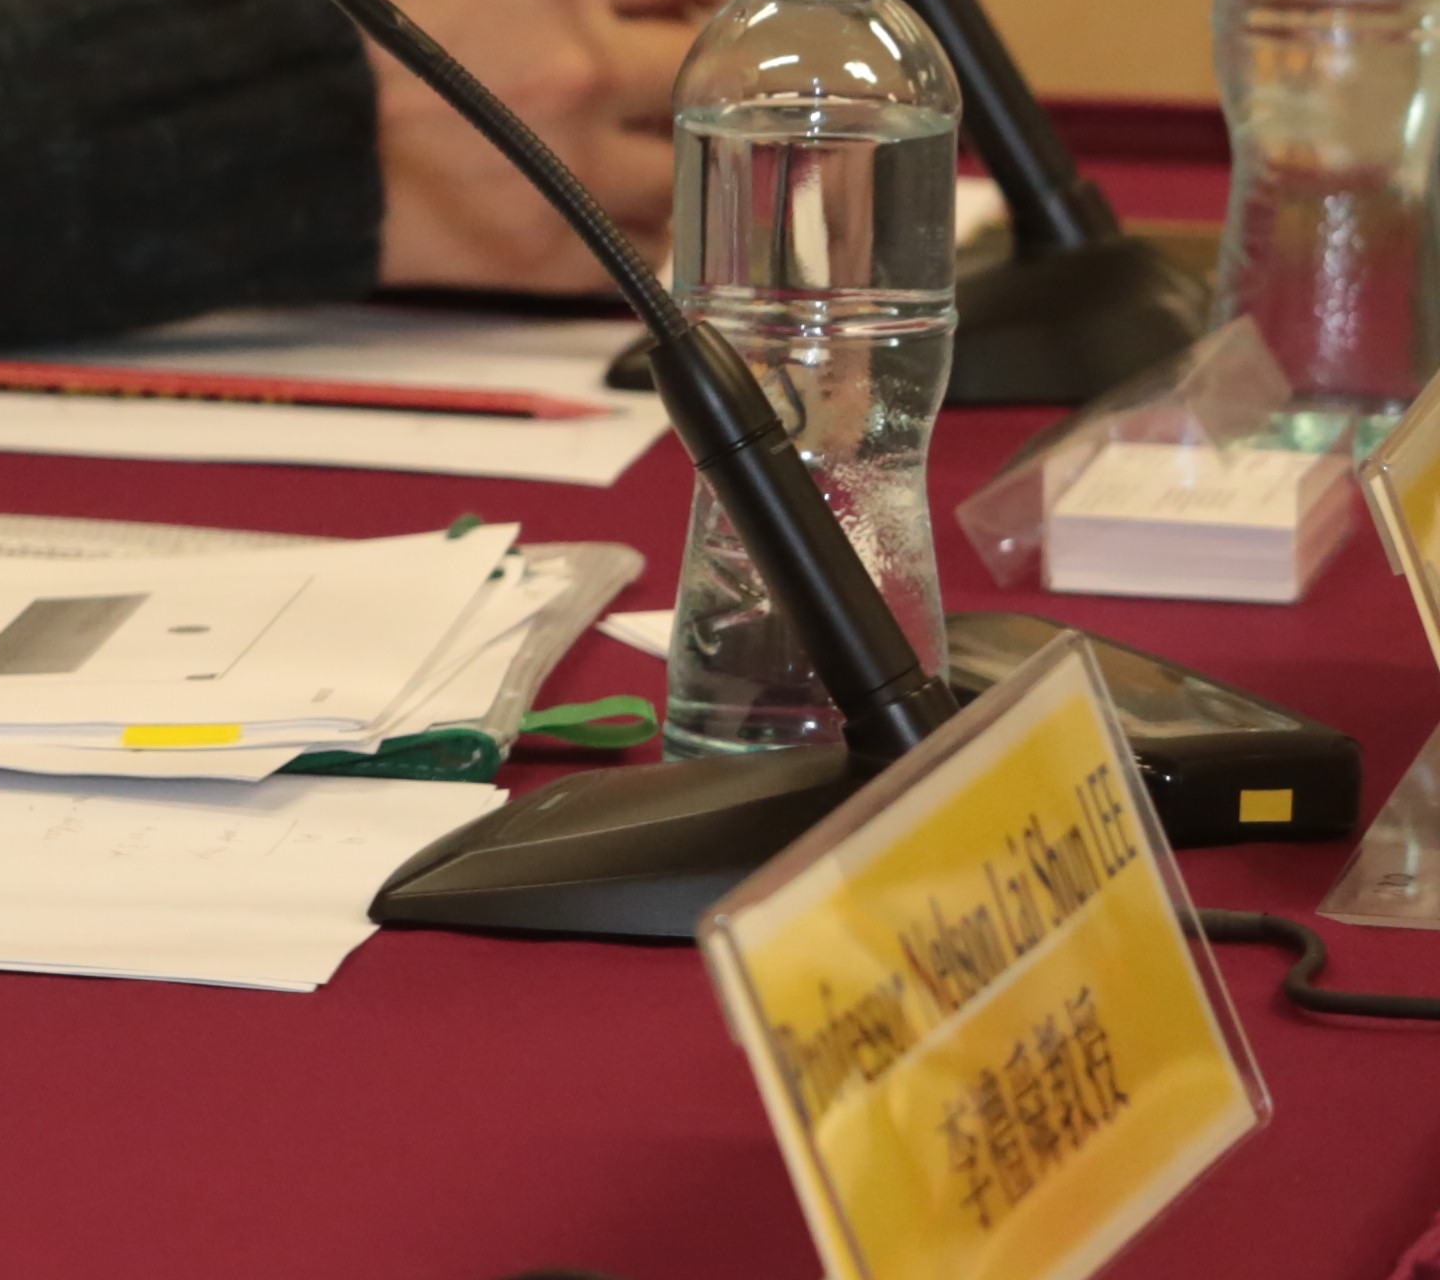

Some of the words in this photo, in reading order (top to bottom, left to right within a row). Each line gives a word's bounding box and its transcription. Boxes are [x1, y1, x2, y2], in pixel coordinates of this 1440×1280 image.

[897, 894, 1009, 1017] Nelson
[984, 834, 1046, 958] Lai
[1023, 813, 1101, 929] Shun
[1075, 763, 1138, 879] LEE
